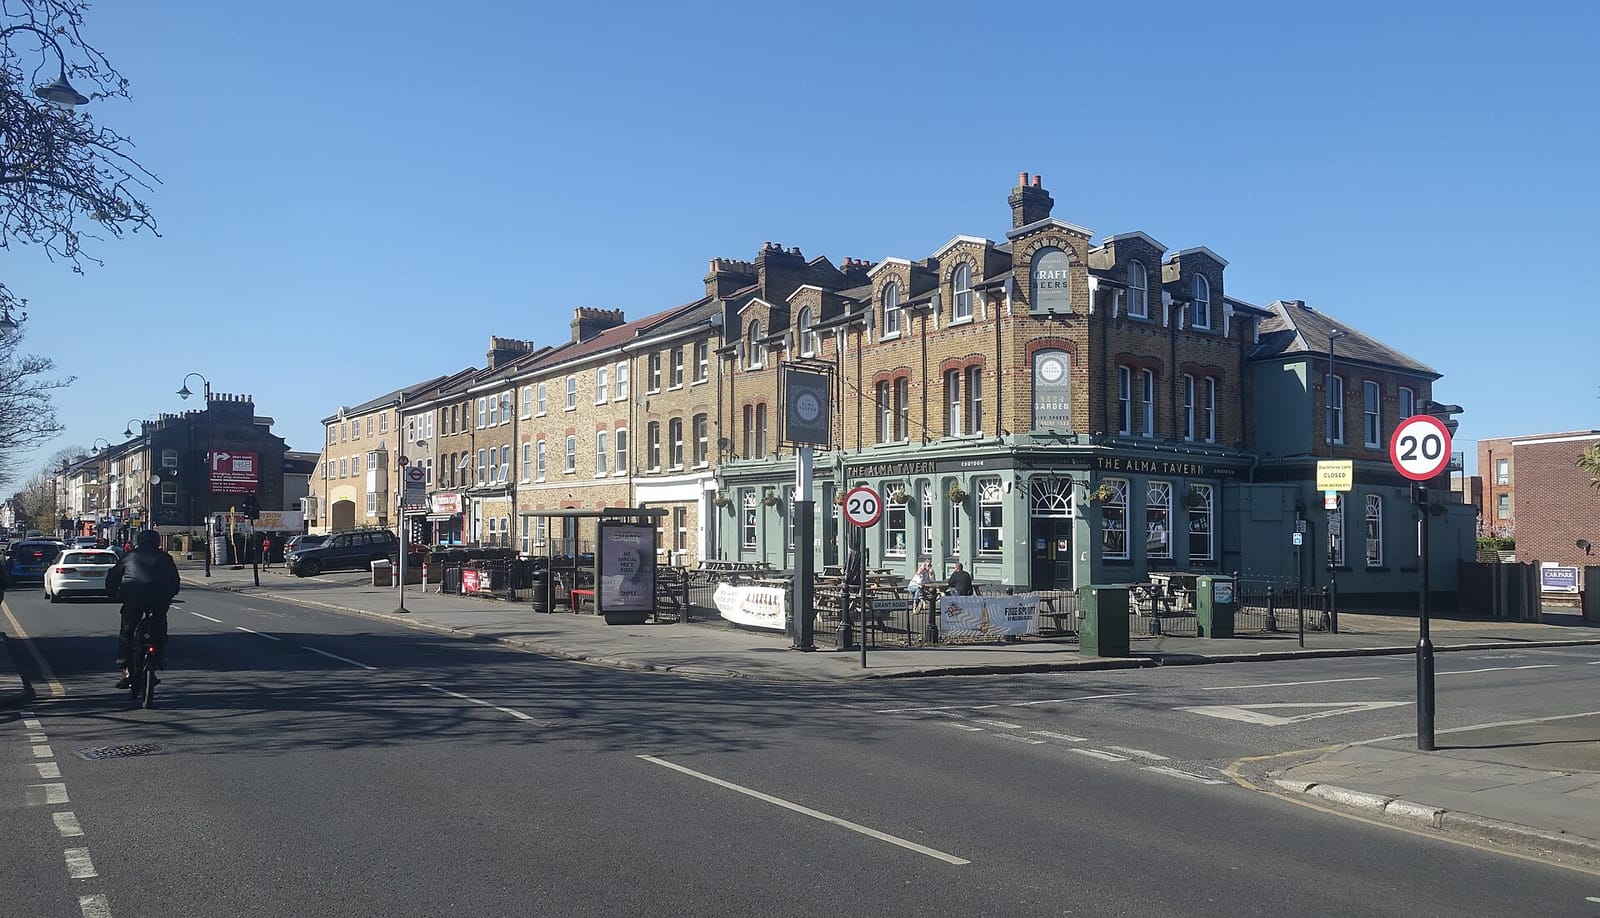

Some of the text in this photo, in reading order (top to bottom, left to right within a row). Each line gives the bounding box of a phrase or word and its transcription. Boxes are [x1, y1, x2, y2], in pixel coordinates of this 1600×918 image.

[1033, 270, 1068, 280] CRAFT
[1033, 281, 1068, 289] BEERS
[1040, 395, 1064, 403] BEER
[1400, 434, 1442, 461] 20
[848, 467, 865, 477] THE
[869, 465, 893, 476] ALMA
[898, 461, 936, 474] TAVERN
[1097, 457, 1121, 470] THE
[1127, 460, 1158, 473] ALMA
[1162, 462, 1205, 475] TAVERN
[849, 499, 876, 515] 20
